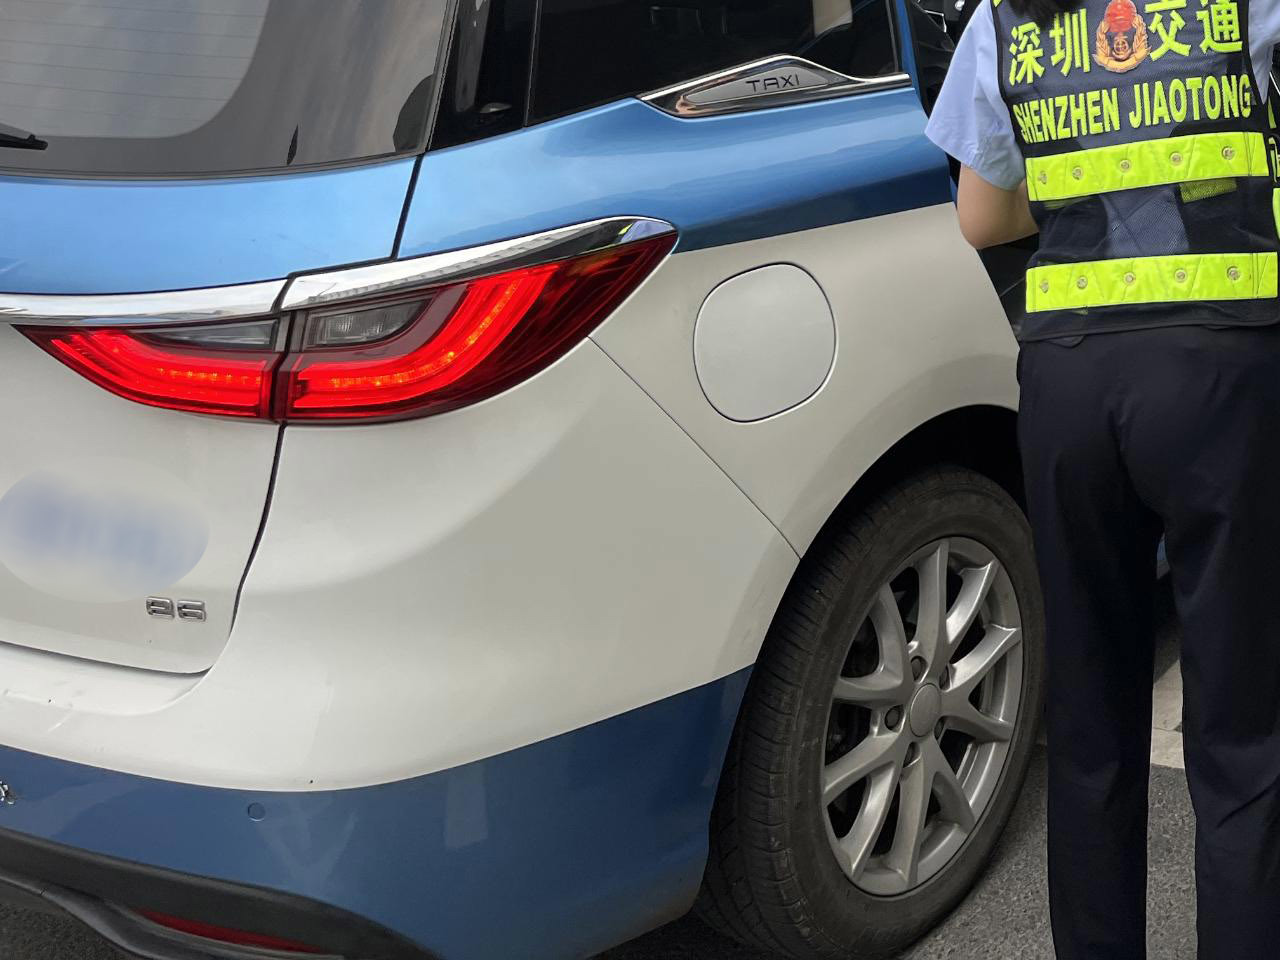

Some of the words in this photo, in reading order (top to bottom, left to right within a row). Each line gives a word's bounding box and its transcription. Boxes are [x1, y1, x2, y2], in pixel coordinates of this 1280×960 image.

[745, 73, 800, 93] TAXI
[1009, 8, 1091, 87] 深圳
[1012, 87, 1120, 145] SHENZHEN
[1128, 73, 1251, 129] JIAOTONG
